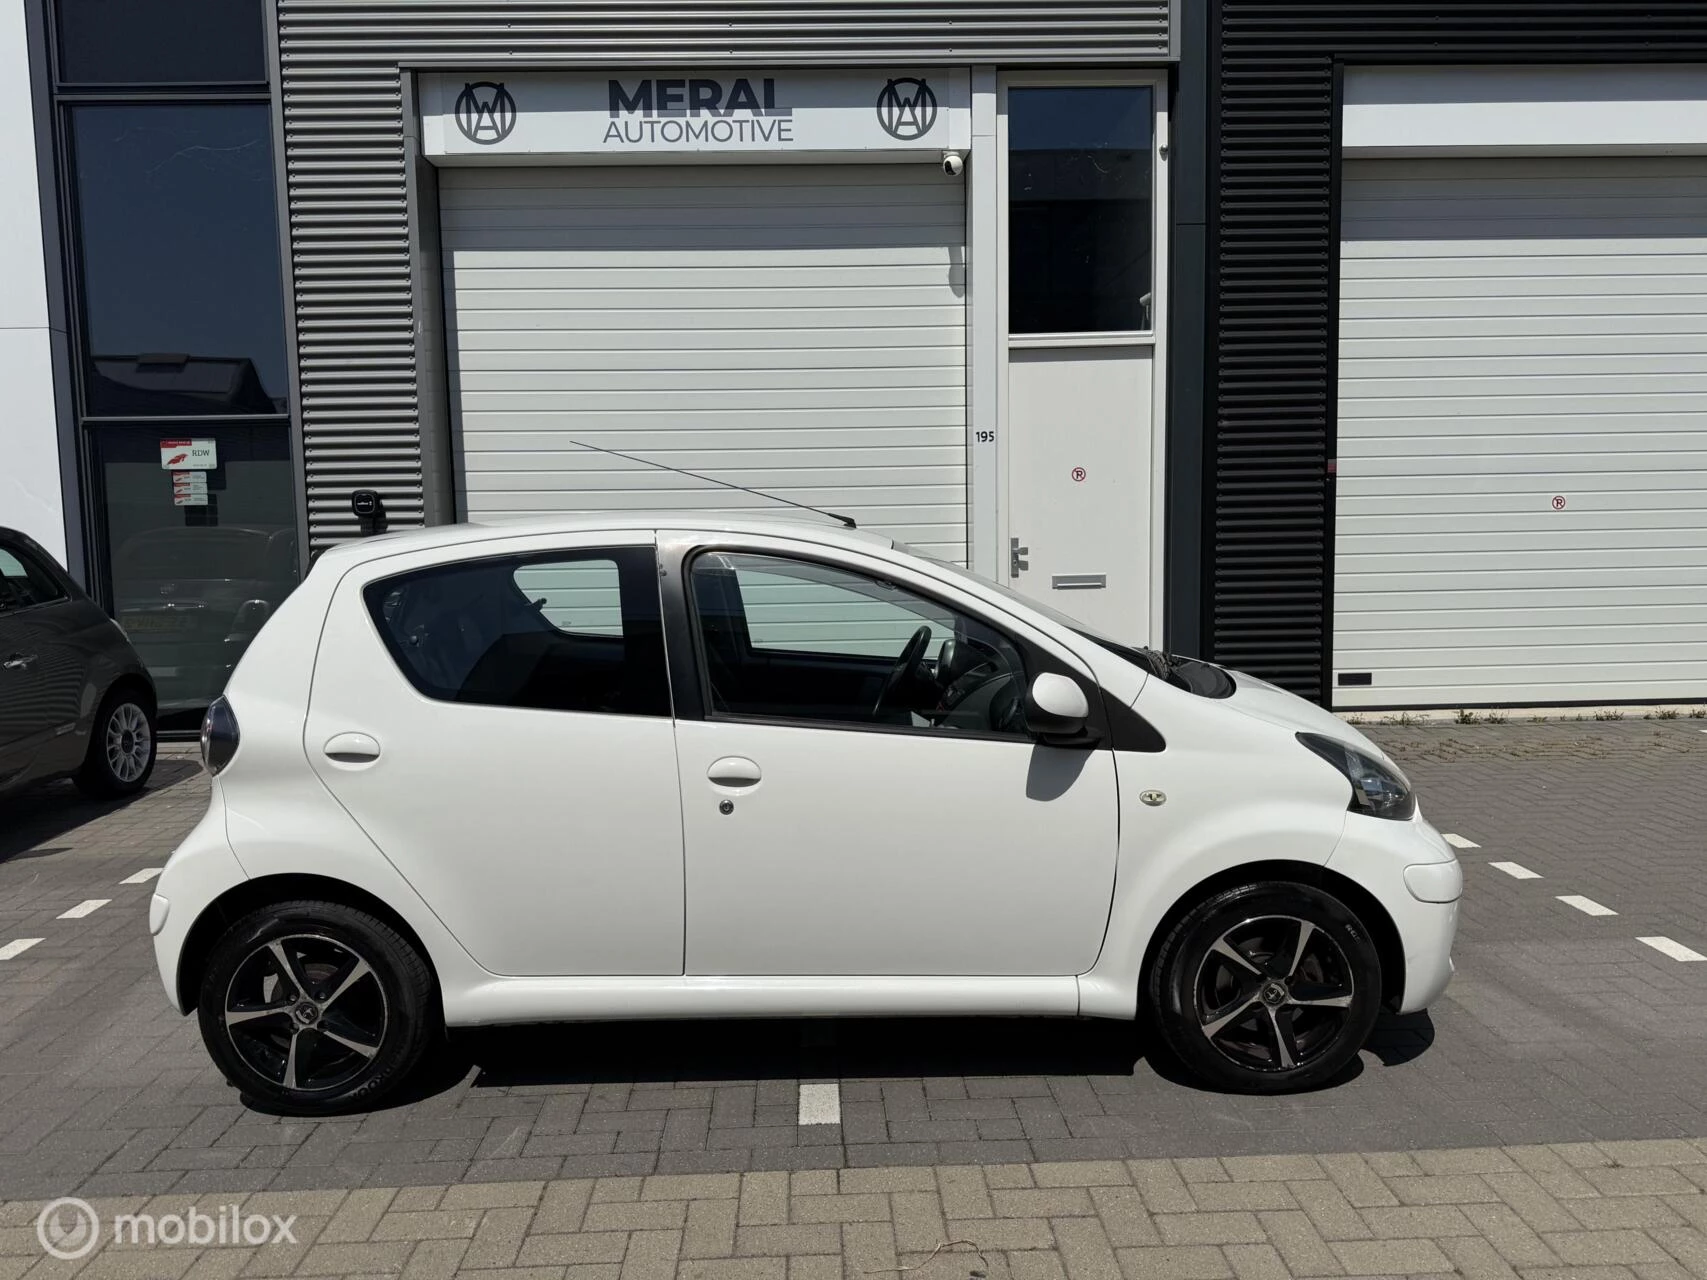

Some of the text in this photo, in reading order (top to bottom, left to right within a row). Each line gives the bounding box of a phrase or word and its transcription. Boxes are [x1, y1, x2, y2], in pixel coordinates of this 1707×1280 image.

[609, 79, 793, 118] MERAL
[603, 119, 794, 143] AUTOMOTIVE
[975, 431, 995, 442] 195
[191, 449, 210, 457] RDW
